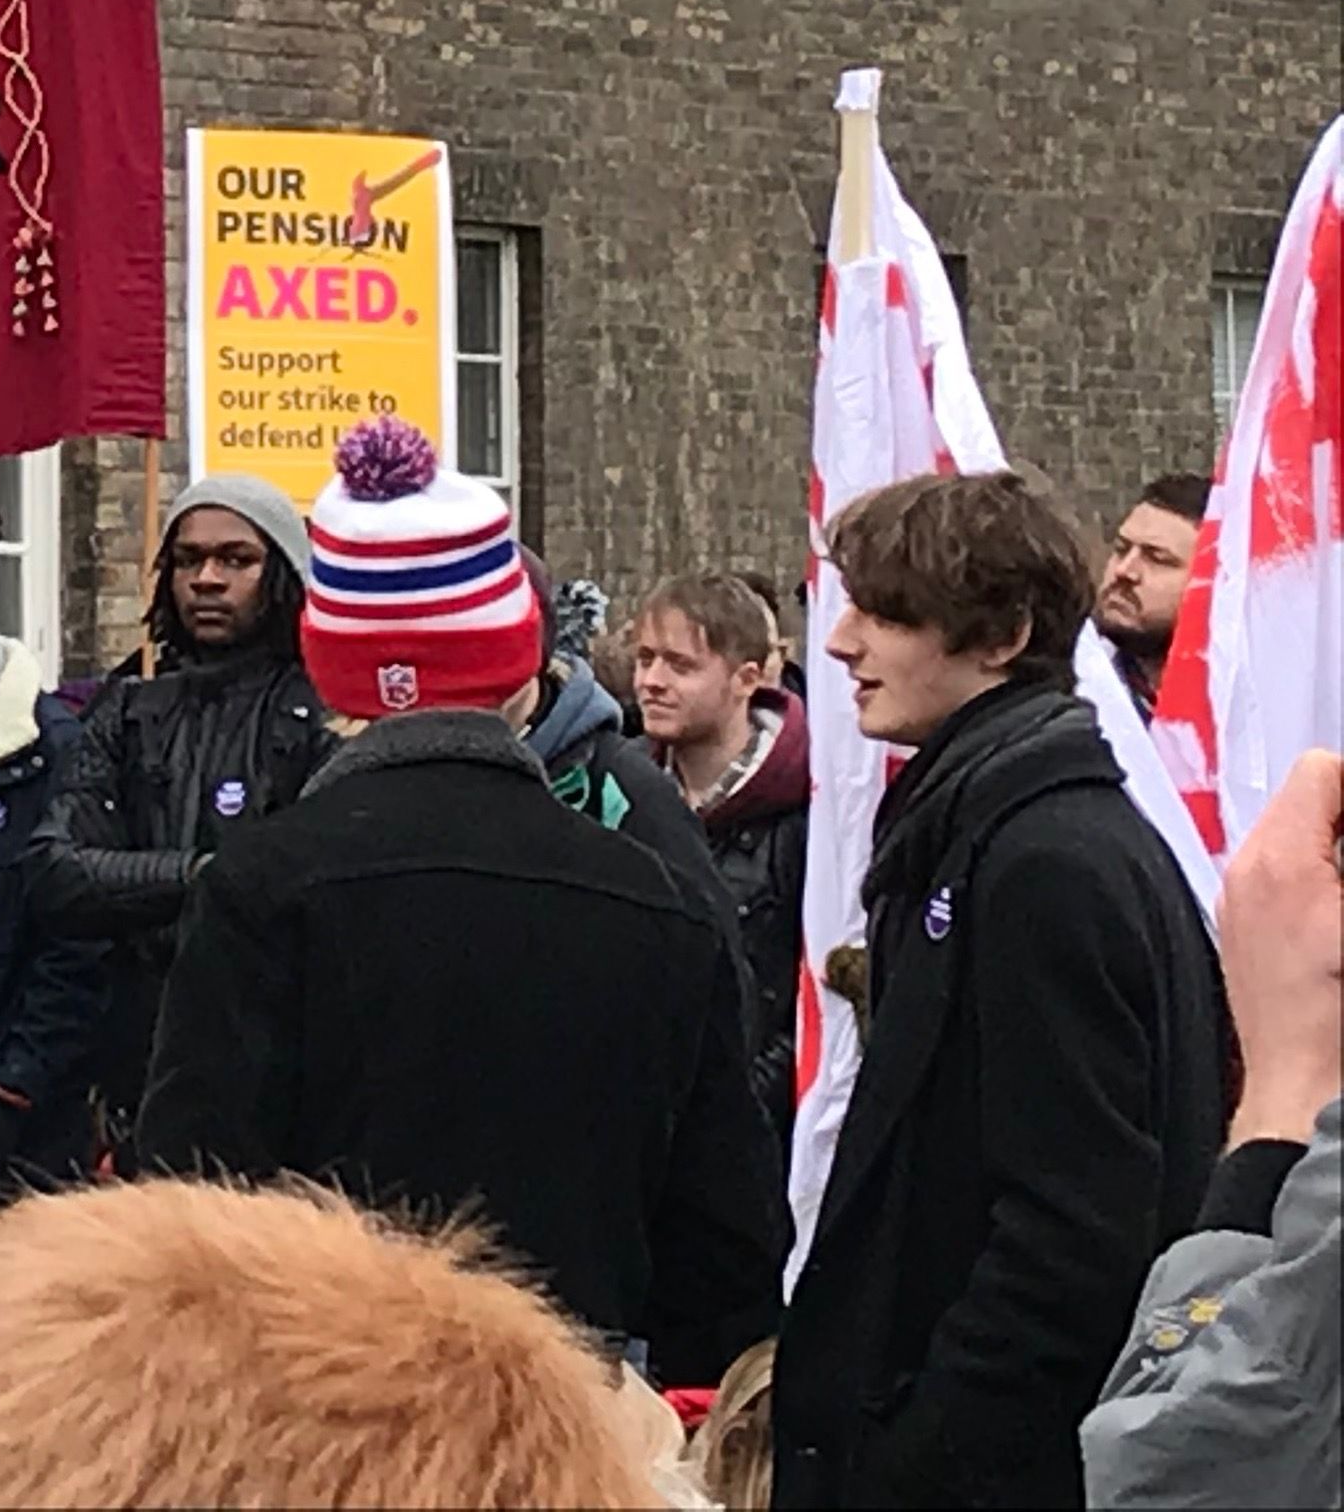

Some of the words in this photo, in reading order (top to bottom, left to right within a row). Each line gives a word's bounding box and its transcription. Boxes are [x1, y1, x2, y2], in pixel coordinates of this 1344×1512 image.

[216, 166, 307, 201] OUR
[216, 211, 411, 255] PENSION
[215, 263, 420, 327] AXED.
[218, 345, 342, 377] Support
[218, 388, 268, 411] our
[277, 387, 362, 414] strike
[368, 390, 398, 415] to
[219, 422, 323, 449] defend
